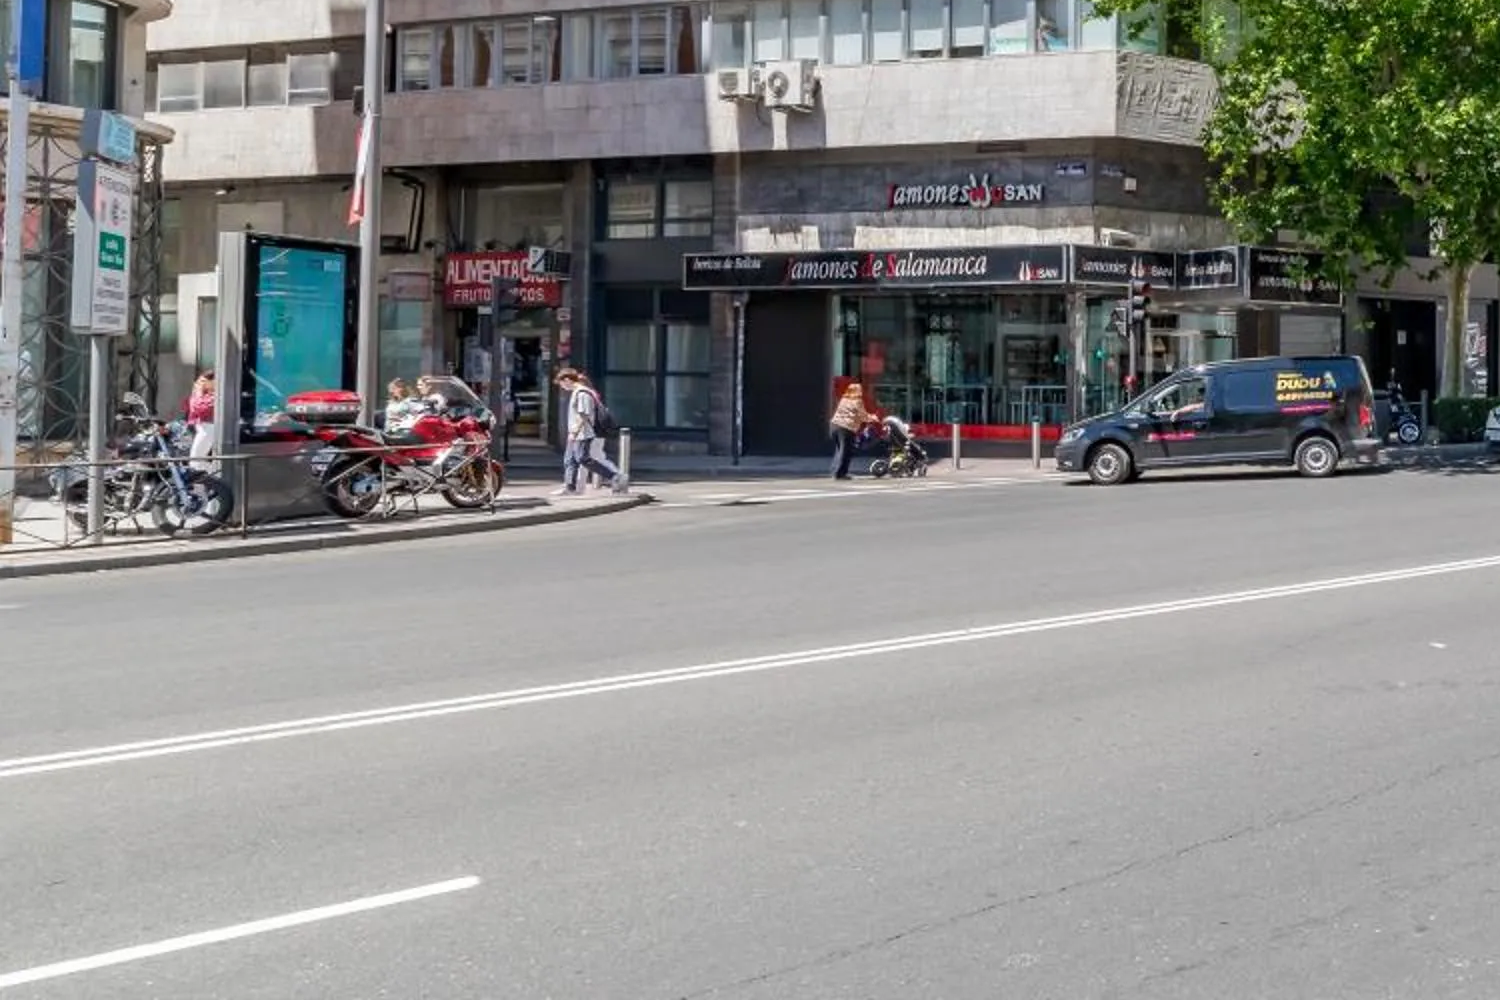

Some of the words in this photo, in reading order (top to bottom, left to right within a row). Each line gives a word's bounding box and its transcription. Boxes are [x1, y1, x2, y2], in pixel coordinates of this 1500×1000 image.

[446, 259, 557, 284] ALIMENTAC
[861, 253, 883, 278] de
[885, 251, 988, 280] Salamanca
[453, 287, 491, 304] FRUTO
[1277, 377, 1321, 391] DUDU
